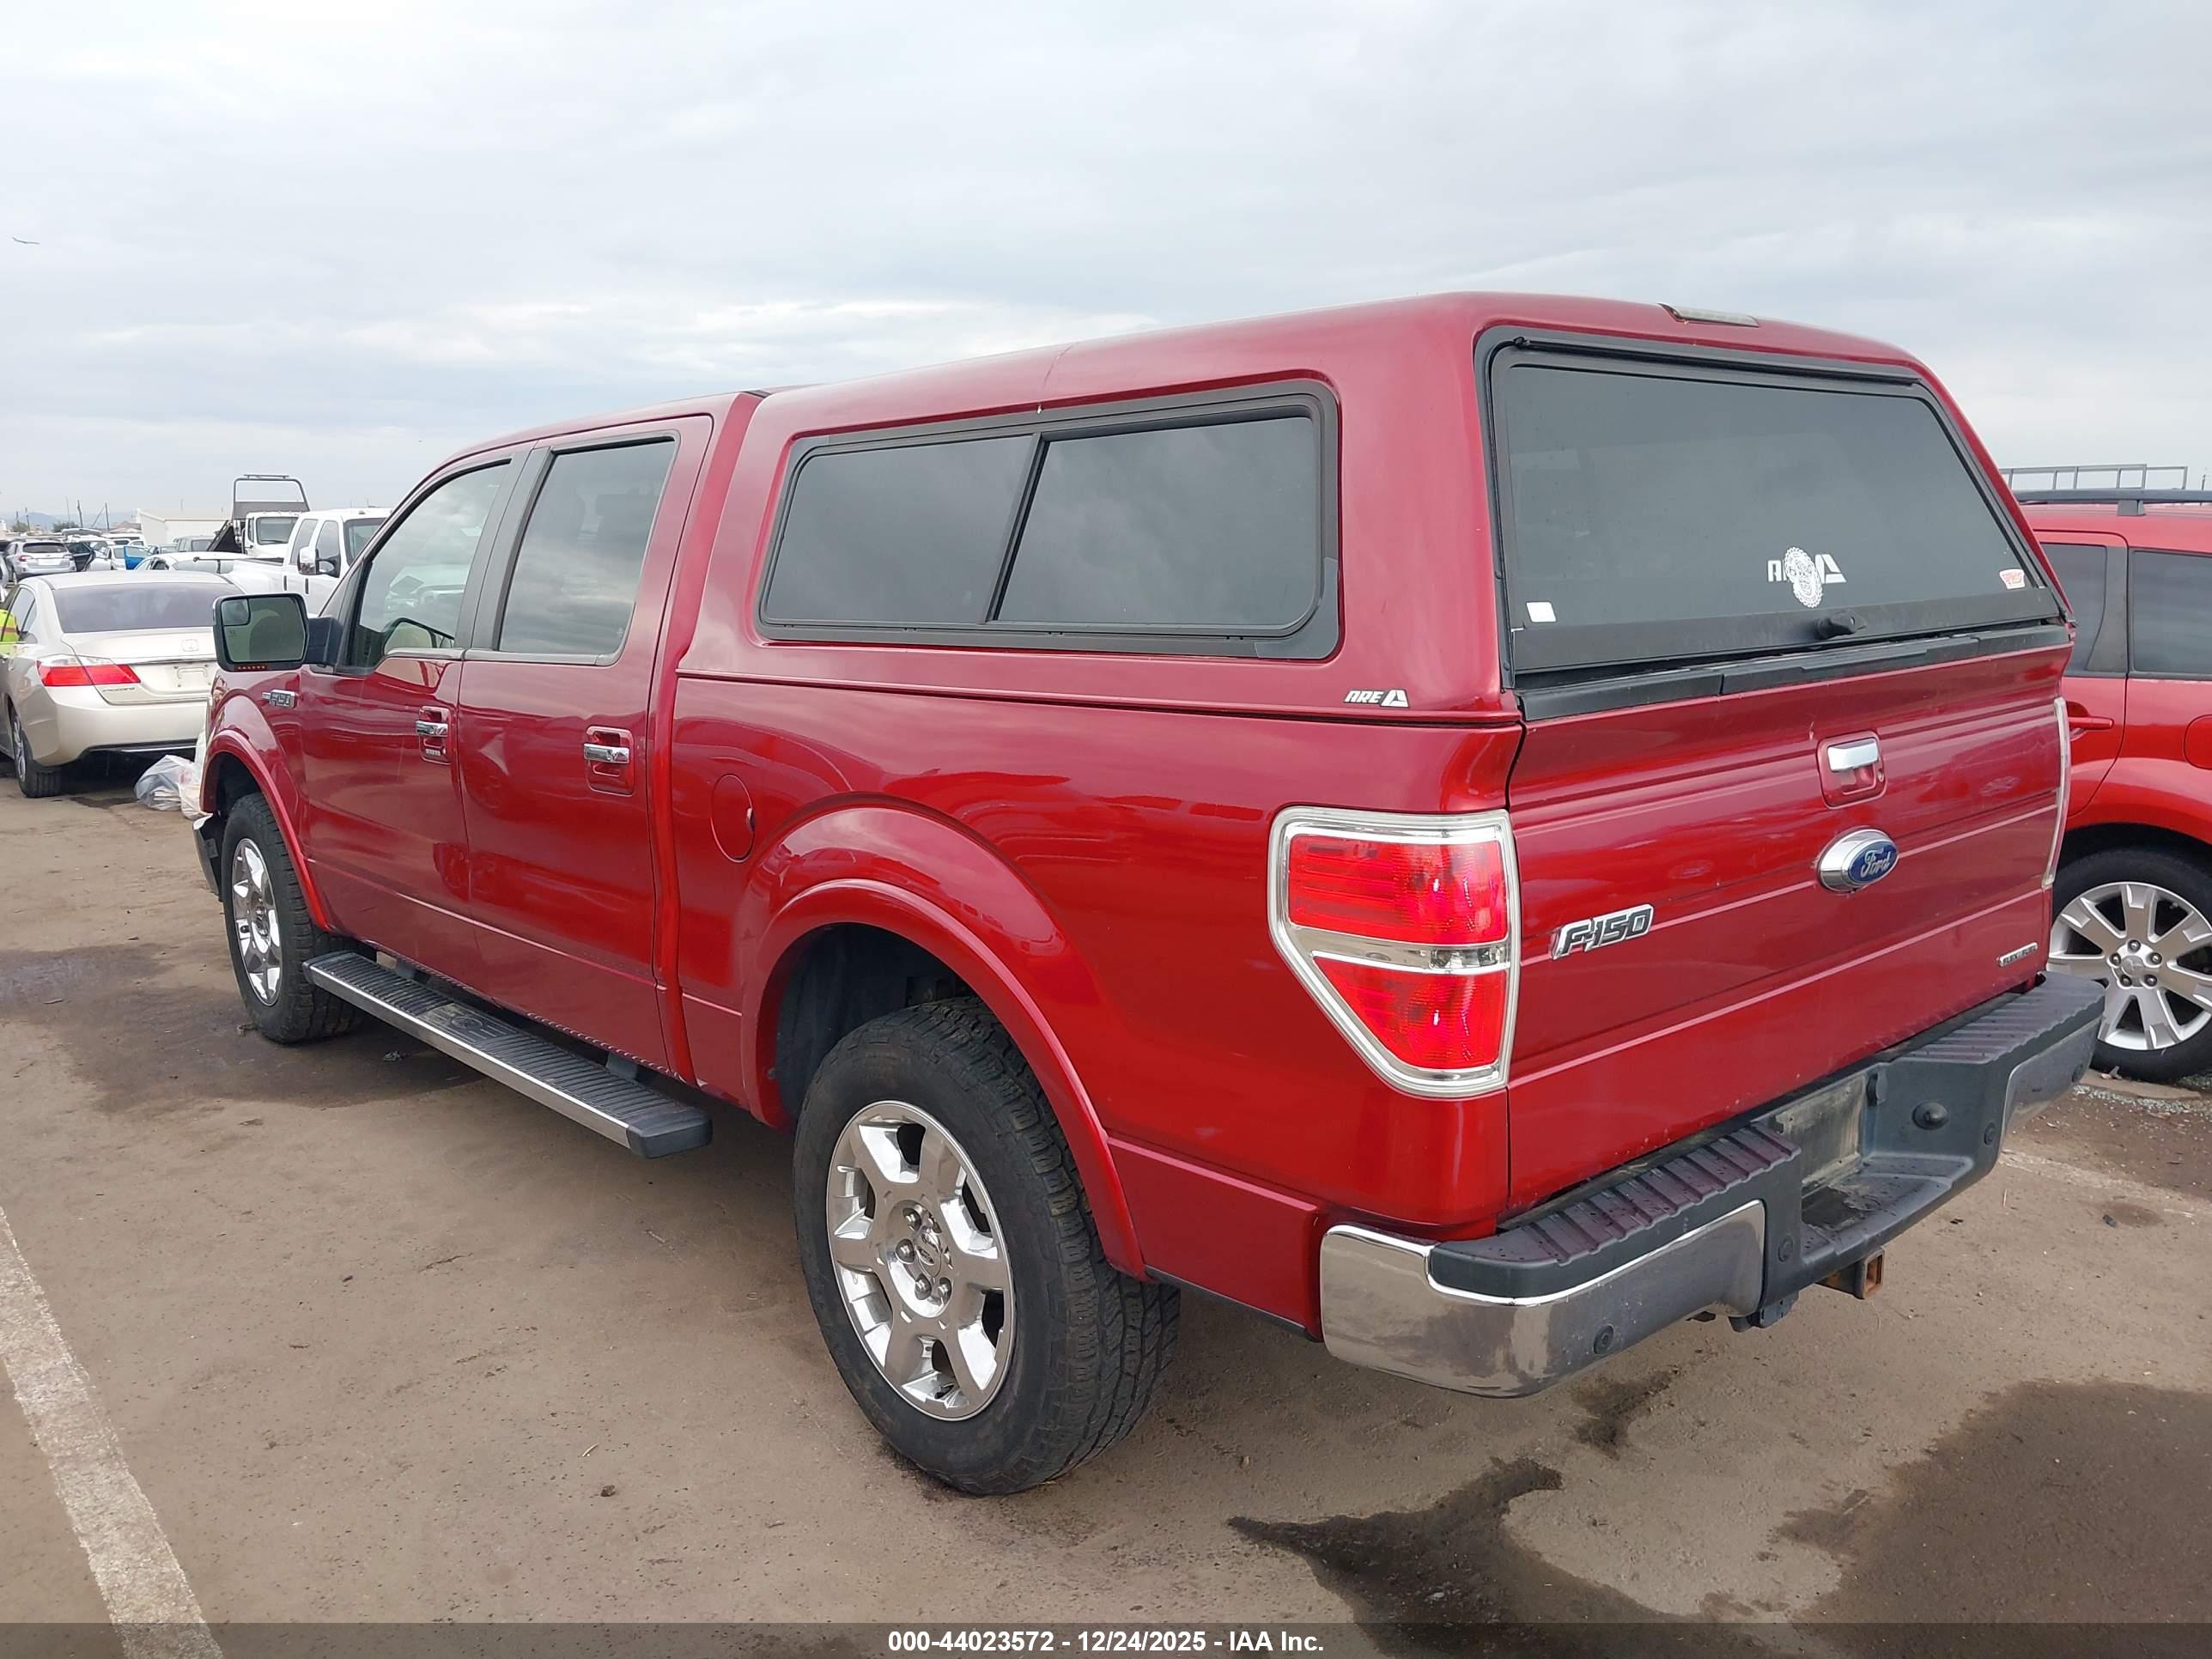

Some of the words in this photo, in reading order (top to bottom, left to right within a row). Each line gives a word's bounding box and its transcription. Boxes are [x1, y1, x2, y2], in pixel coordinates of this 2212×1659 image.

[1344, 690, 1385, 704] ARE
[1860, 848, 1891, 878] Ford
[1557, 905, 1653, 957] F-150
